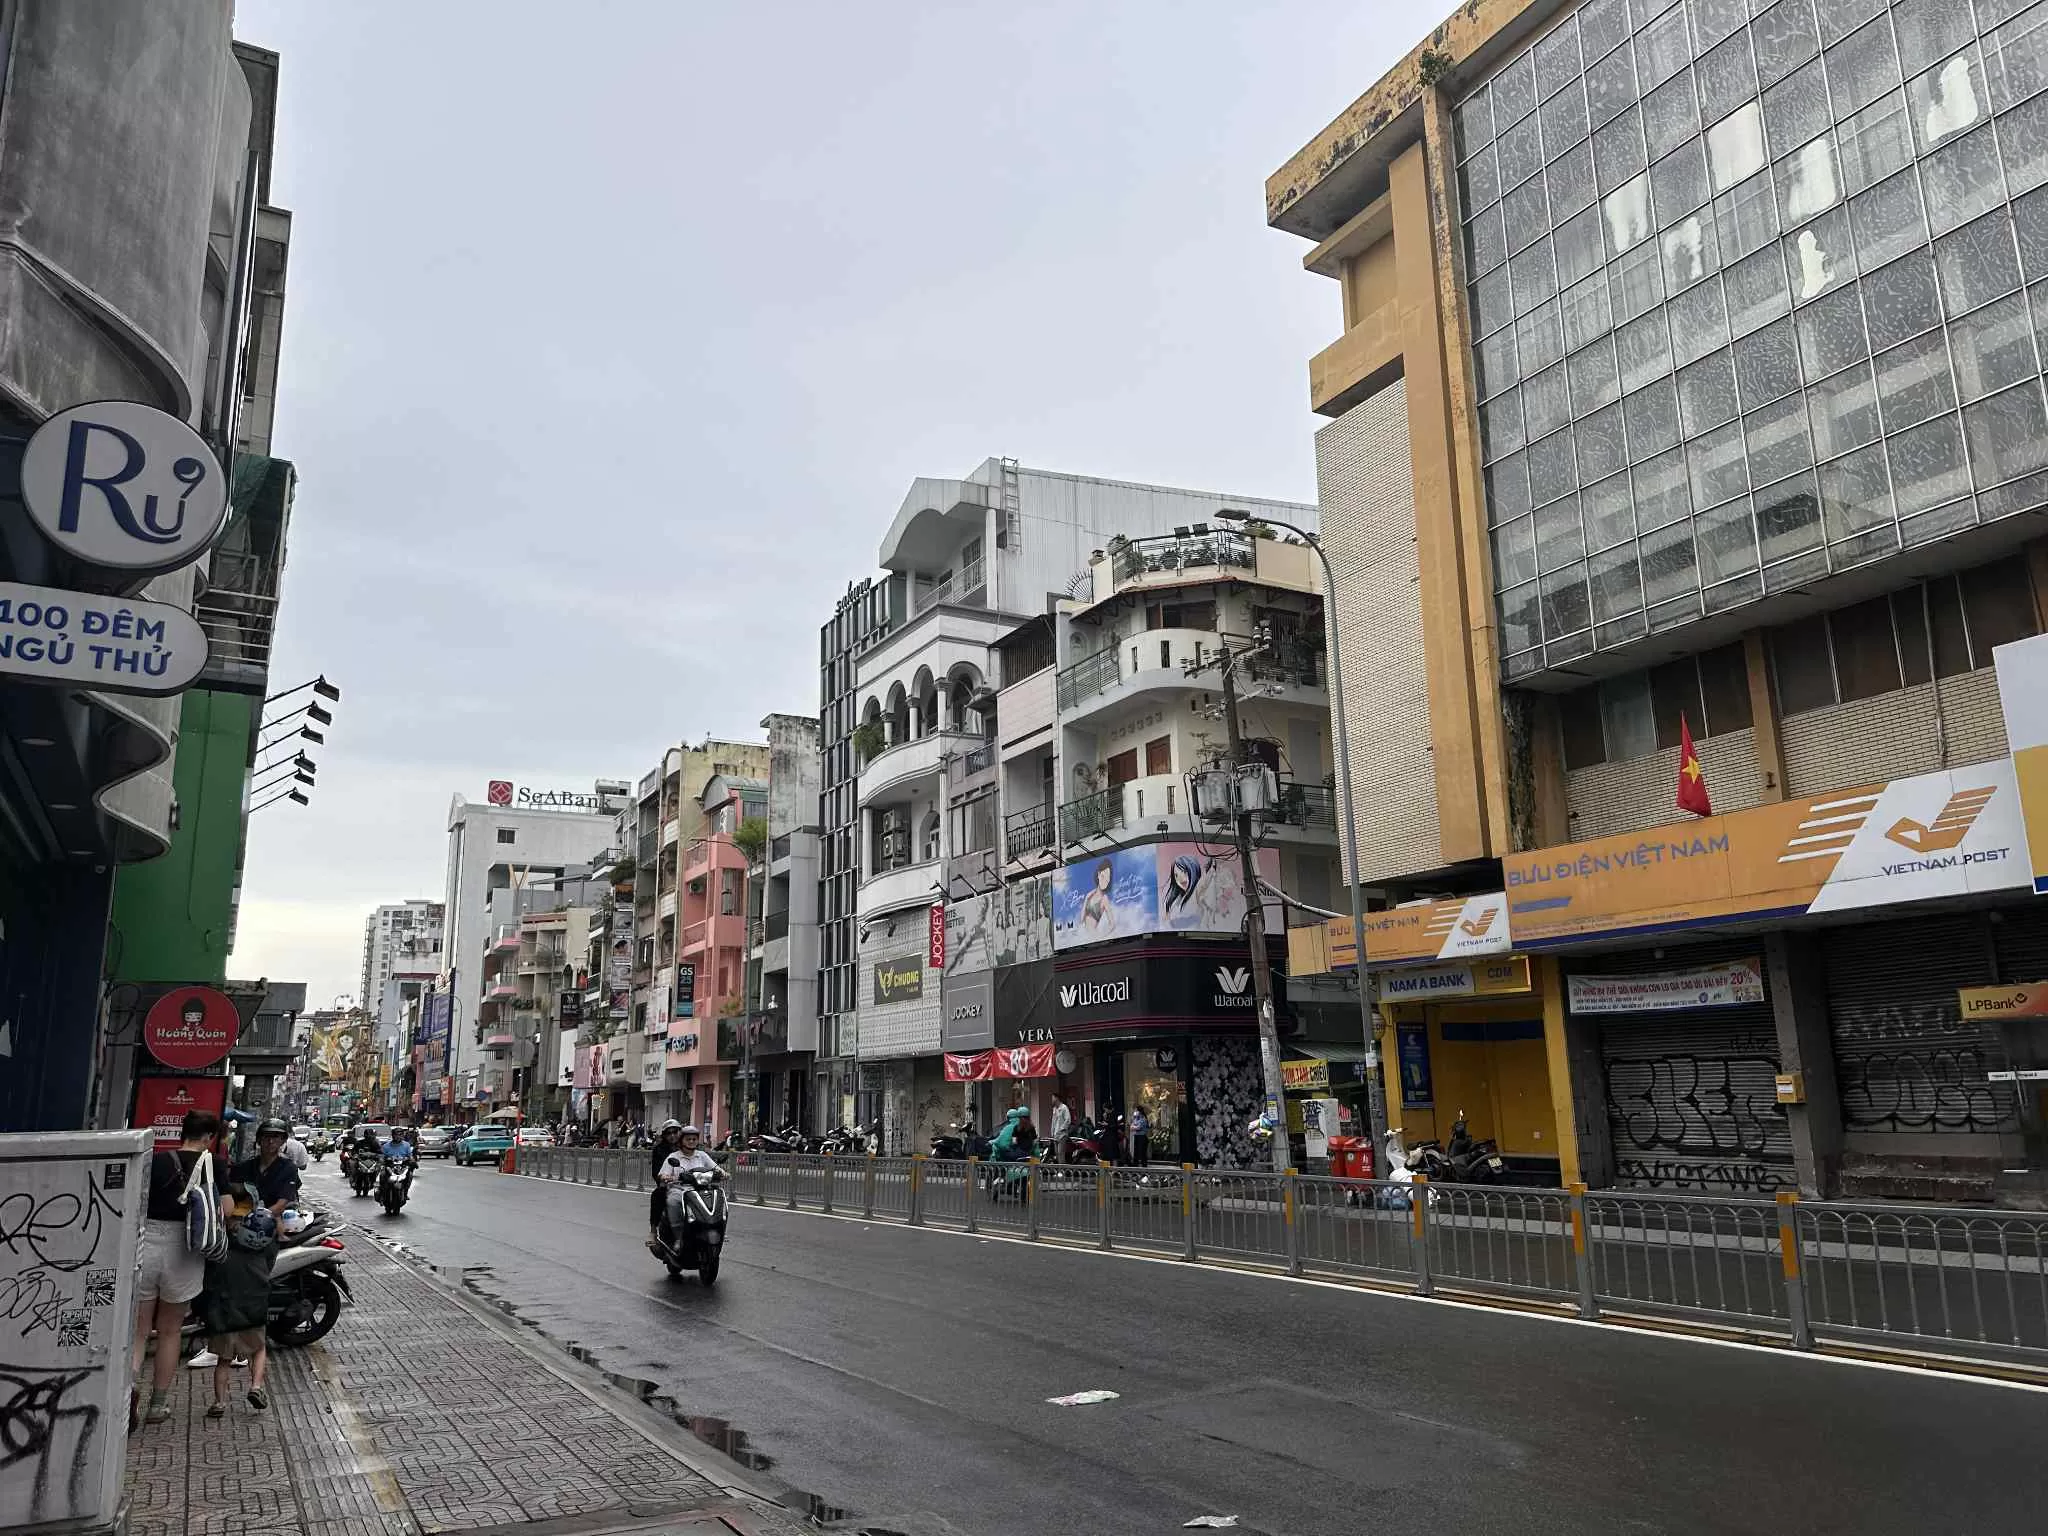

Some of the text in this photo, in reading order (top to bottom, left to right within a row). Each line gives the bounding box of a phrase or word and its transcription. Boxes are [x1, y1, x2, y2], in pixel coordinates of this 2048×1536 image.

[0, 599, 166, 644] 100 ĐÊM
[88, 645, 173, 677] THỬ
[518, 786, 611, 809] SeABank
[1507, 834, 1729, 888] BƯU ĐIỆN VIỆT NAM
[1881, 847, 2010, 877] VIETNAM POST
[1398, 915, 1419, 928] NAM
[931, 909, 943, 965] JOCKEY
[1456, 938, 1483, 949] VIETNAM
[680, 966, 694, 976] GS
[1487, 966, 1513, 979] CDM
[1730, 968, 1753, 985] 20%
[680, 976, 692, 985] 25
[1389, 978, 1418, 993] NAM
[1429, 973, 1465, 990] BANK
[1078, 976, 1130, 1006] Wacoal
[1214, 994, 1253, 1008] Wacoal
[1968, 997, 2017, 1011] LPBank
[951, 1003, 983, 1021] JOCKEY
[1018, 1028, 1054, 1043] VERA
[1009, 1046, 1030, 1077] 80
